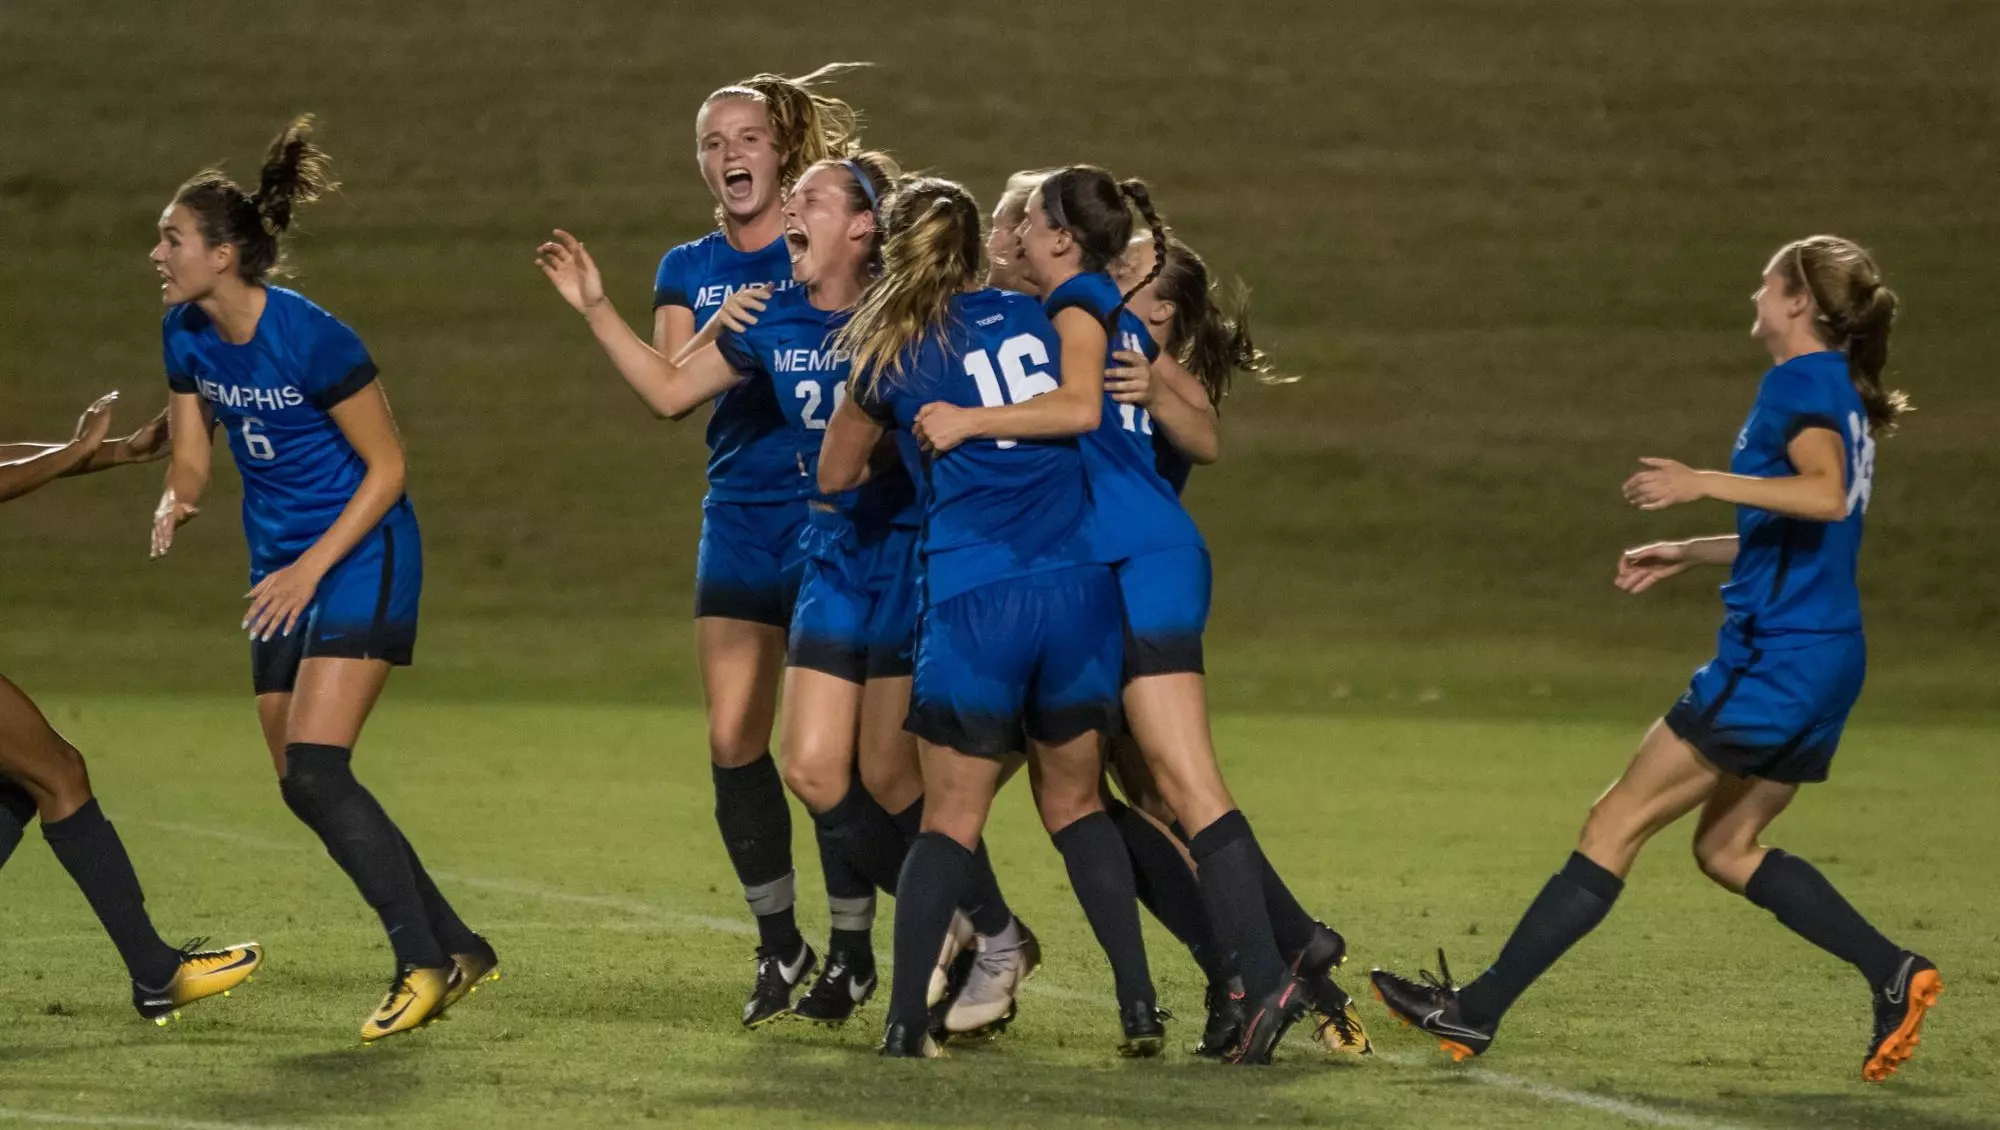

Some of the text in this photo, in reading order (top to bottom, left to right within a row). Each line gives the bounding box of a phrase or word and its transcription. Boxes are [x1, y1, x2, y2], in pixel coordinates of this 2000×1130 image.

[975, 313, 1004, 327] TIGERS
[963, 333, 1060, 449] 16
[244, 418, 275, 460] 6
